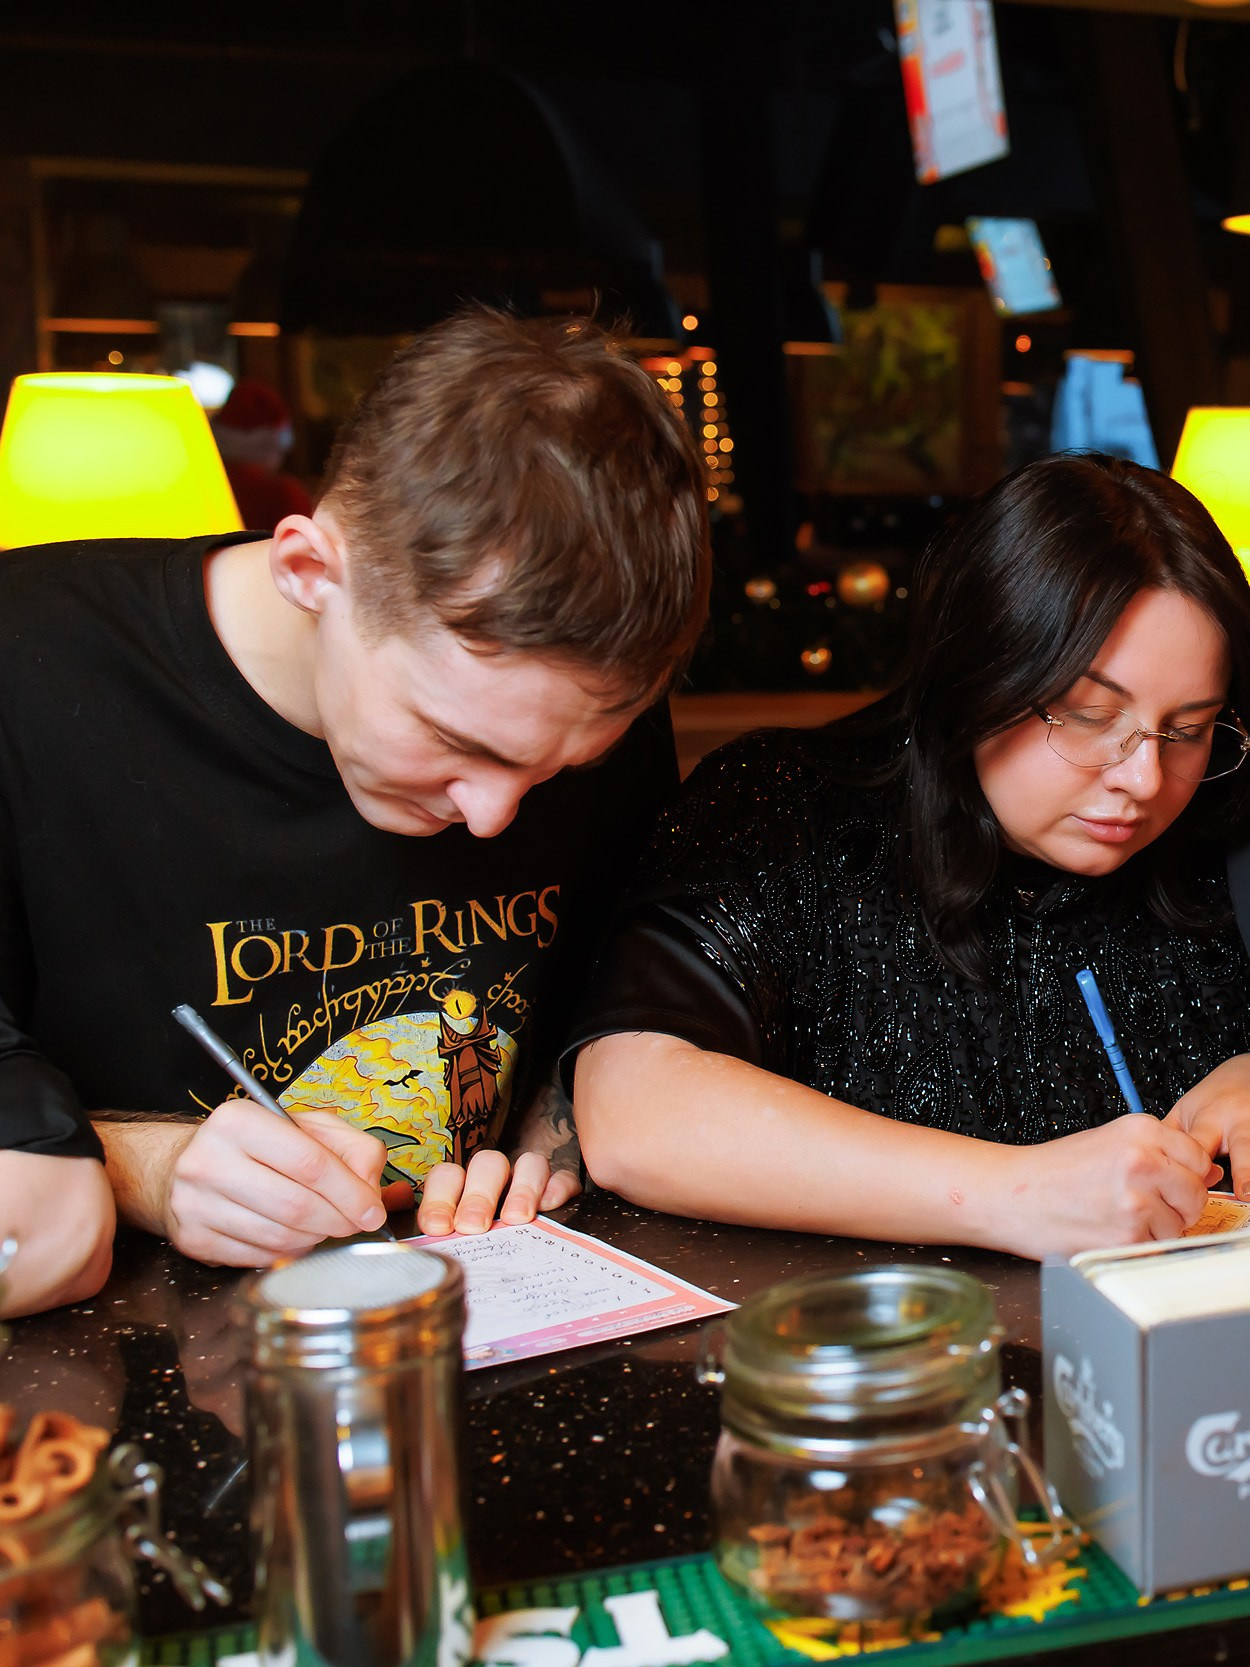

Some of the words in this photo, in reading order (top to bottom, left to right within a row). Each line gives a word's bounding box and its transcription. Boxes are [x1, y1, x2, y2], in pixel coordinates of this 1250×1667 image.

[235, 917, 277, 933] THE
[373, 916, 404, 940] OF
[409, 885, 560, 956] RINGS
[364, 937, 412, 961] THE
[206, 921, 366, 1006] LORD
